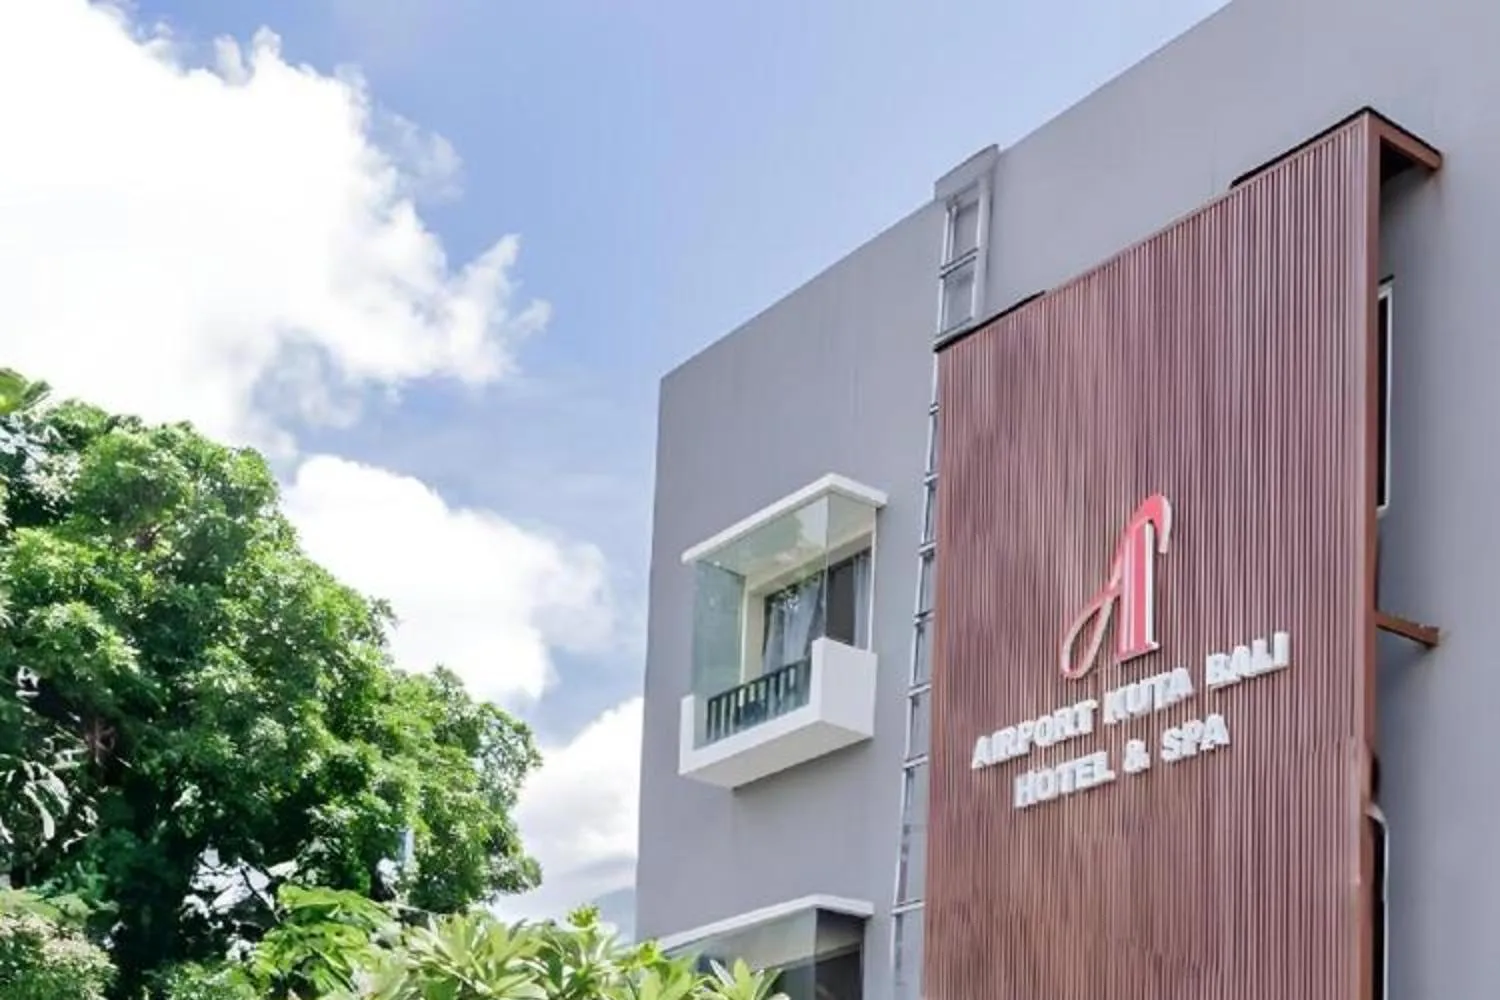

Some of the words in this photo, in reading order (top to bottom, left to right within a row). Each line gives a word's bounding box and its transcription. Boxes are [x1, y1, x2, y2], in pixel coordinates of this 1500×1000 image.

[971, 699, 1098, 769] AIRPORT
[1103, 668, 1194, 724] KUTA
[1205, 631, 1290, 690] BALI
[1014, 751, 1115, 809] HOTEL
[1123, 738, 1151, 773] &
[1161, 713, 1230, 762] SPA
